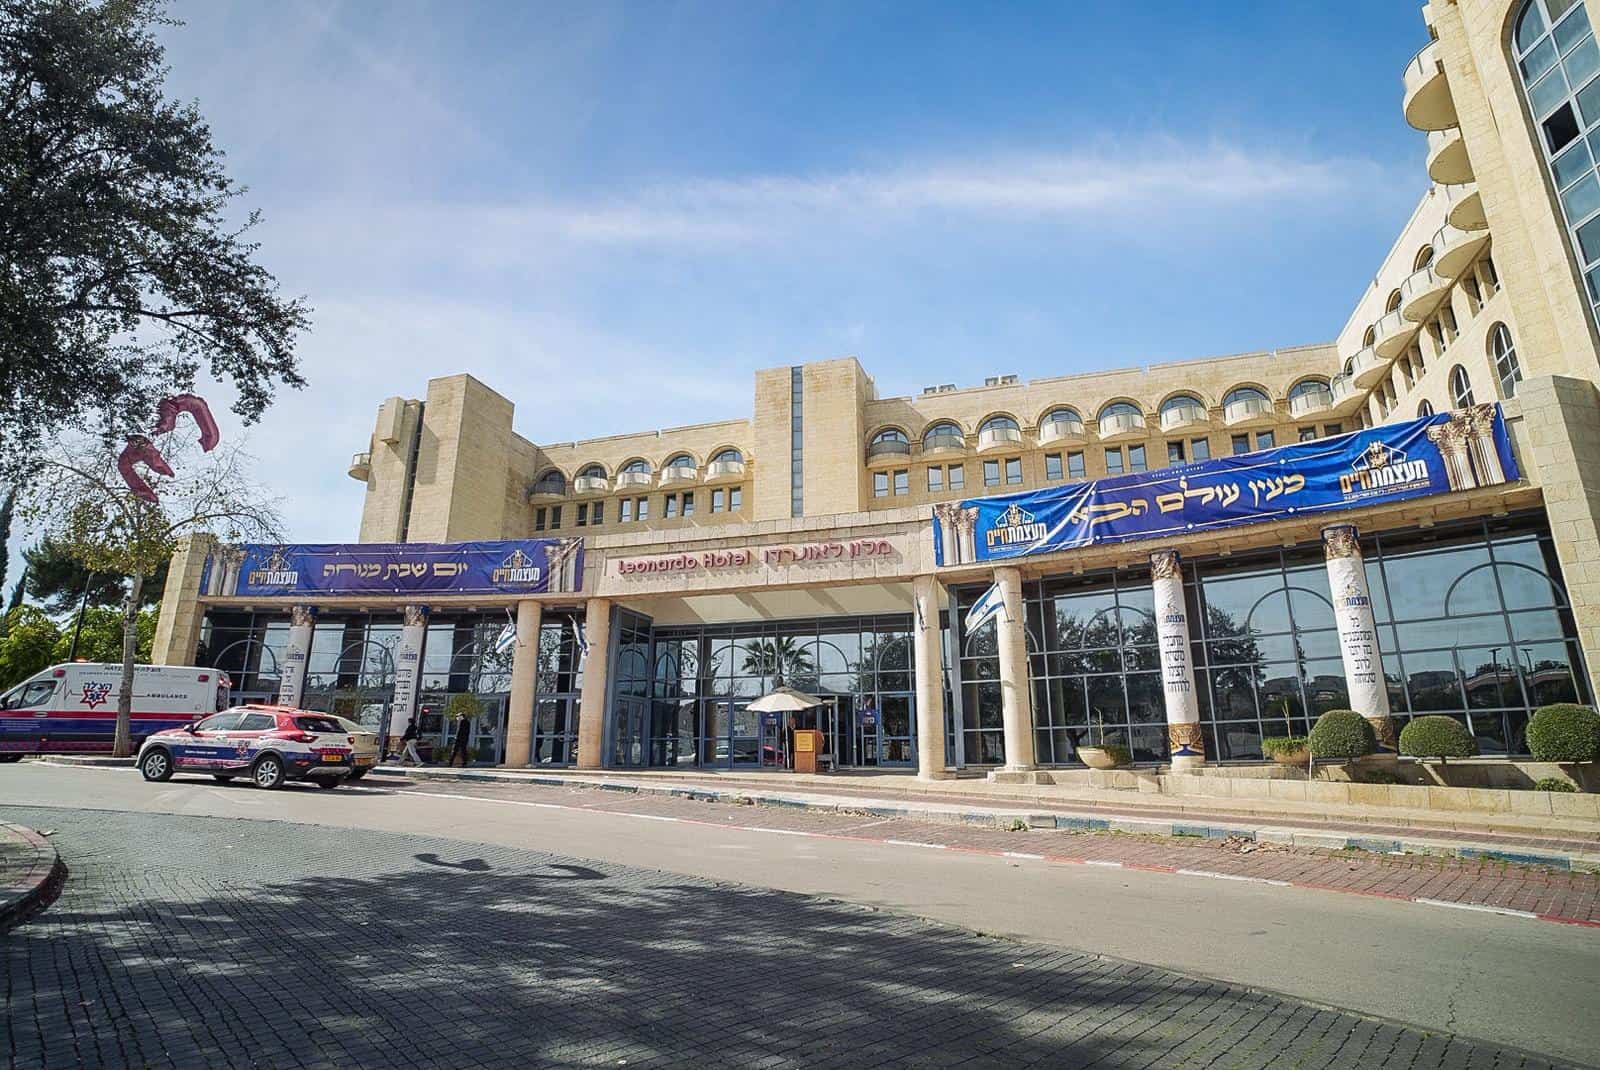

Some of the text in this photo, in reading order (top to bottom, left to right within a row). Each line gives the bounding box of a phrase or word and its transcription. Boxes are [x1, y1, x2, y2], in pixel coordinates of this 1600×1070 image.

[1155, 480, 1240, 514] עולם
[618, 550, 751, 574] Leonardo Hotel
[763, 539, 893, 564] מלון לאונרדו
[323, 562, 469, 580] יום שבת מנוחה
[83, 680, 112, 690] הצלה
